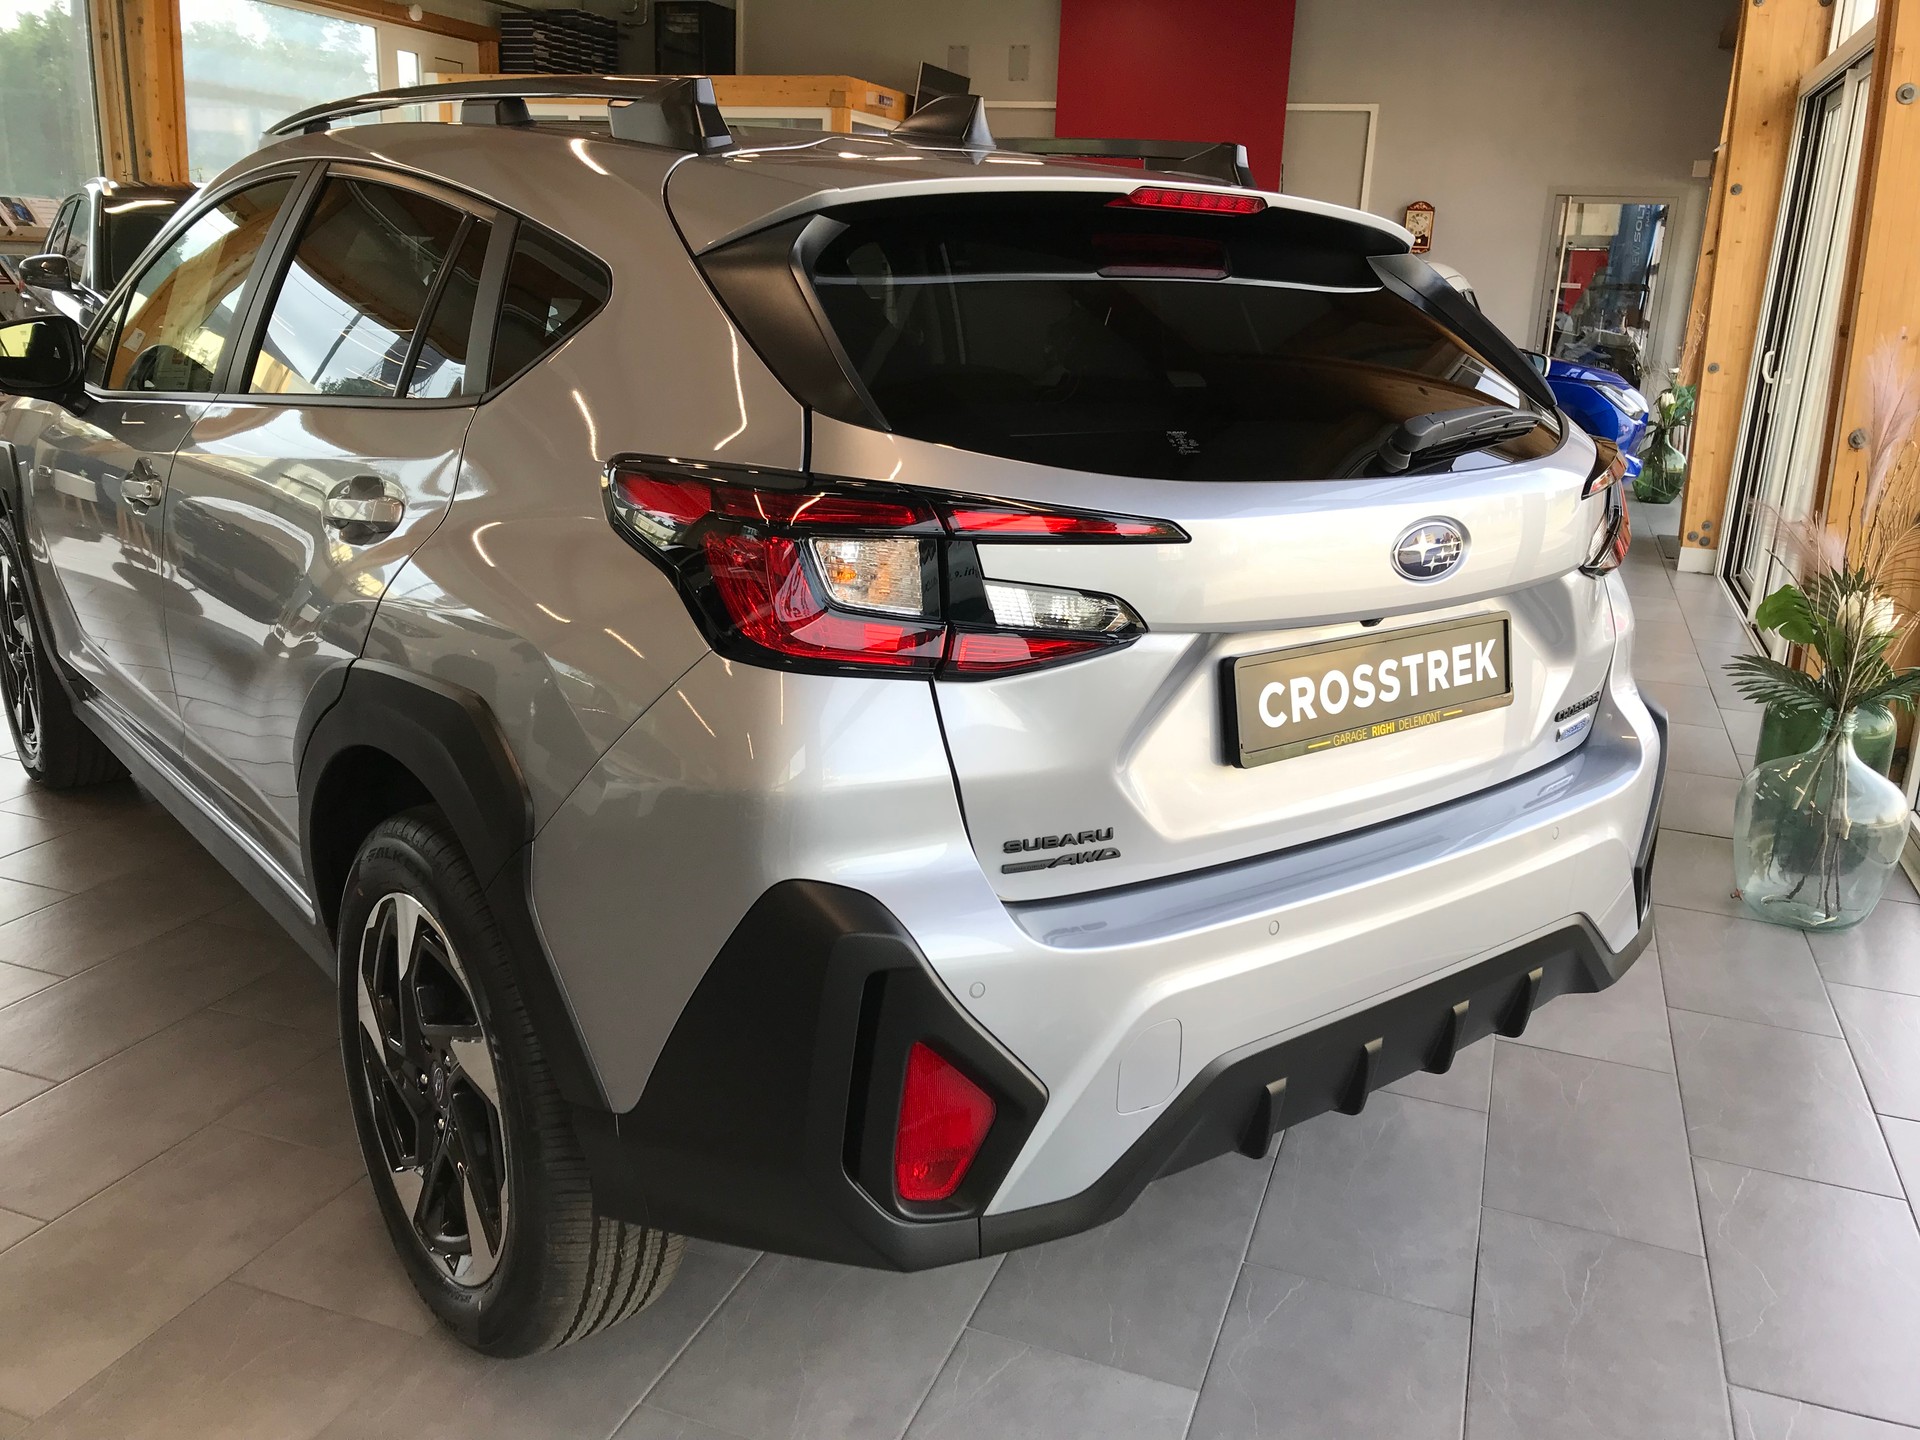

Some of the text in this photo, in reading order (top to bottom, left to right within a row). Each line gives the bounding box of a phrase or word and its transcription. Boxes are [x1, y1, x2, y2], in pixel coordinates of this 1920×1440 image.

[1631, 244, 1640, 272] NEW
[1258, 638, 1498, 728] CROSSTREK
[1333, 710, 1441, 746] GARAGE RIGHI DELEMONT
[1003, 827, 1114, 854] SUBARU
[1047, 847, 1121, 868] AWD
